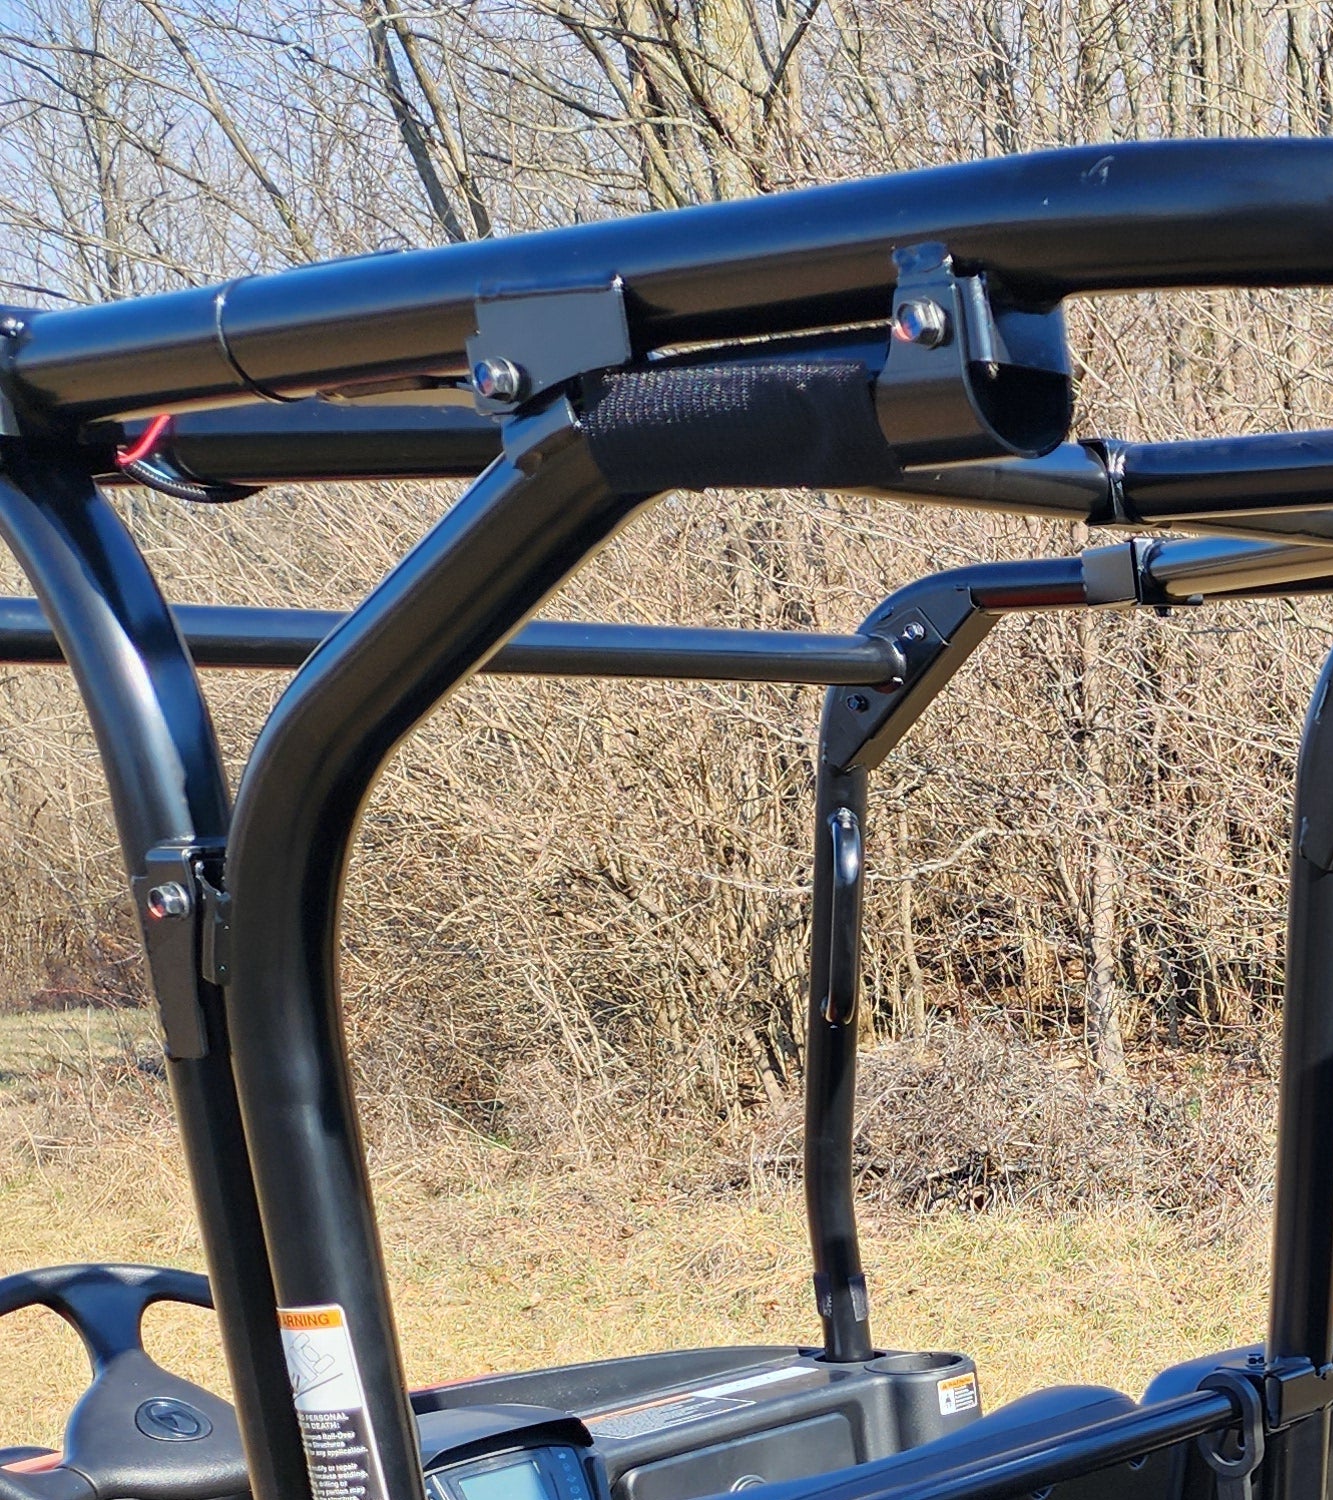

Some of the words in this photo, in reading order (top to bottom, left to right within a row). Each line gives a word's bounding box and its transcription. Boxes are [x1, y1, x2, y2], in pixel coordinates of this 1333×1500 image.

[283, 1313, 330, 1328] ARNING
[306, 1412, 349, 1422] PERSONAL
[311, 1421, 340, 1430] DEATH:
